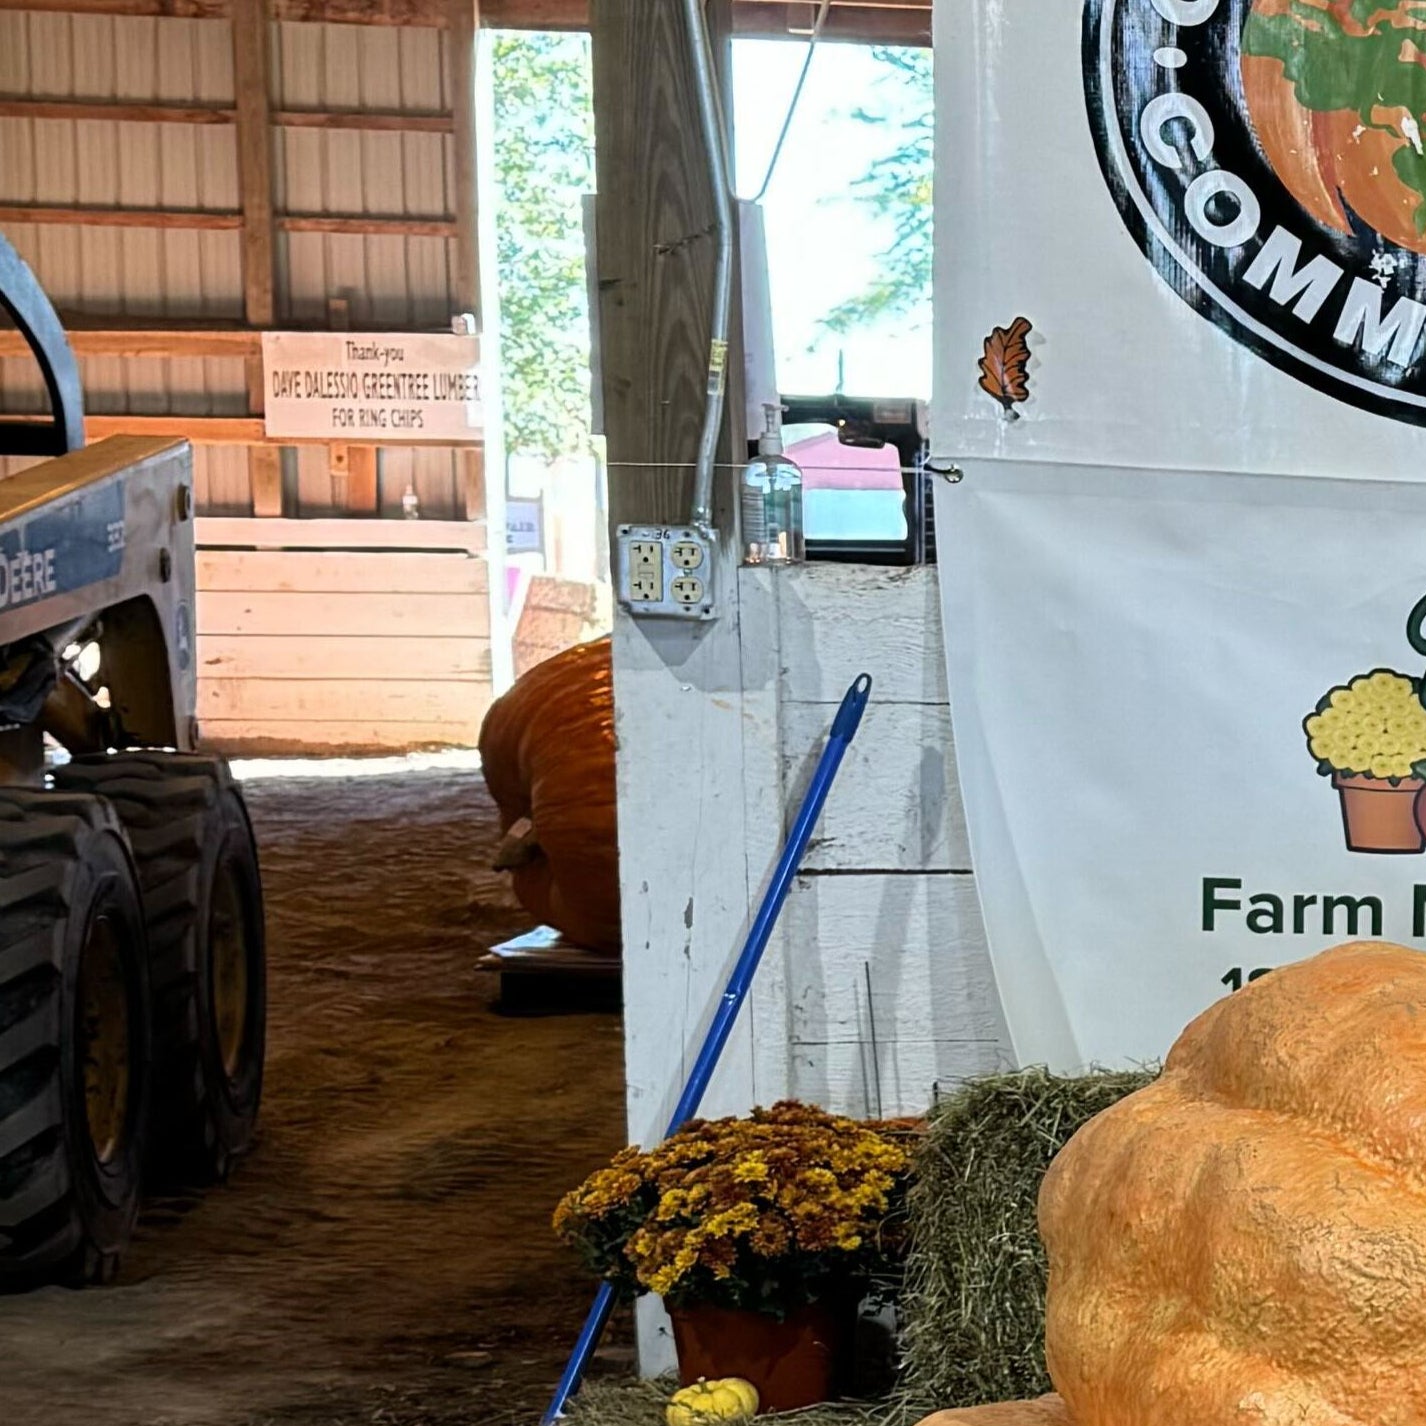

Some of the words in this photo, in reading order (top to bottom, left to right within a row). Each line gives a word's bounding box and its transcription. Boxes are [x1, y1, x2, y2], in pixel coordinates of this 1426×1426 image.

[346, 340, 404, 367] Thank-you
[272, 371, 301, 398] DAVE
[305, 371, 358, 400] DALESSIO
[362, 372, 430, 400] GREENTREE
[432, 373, 481, 401] LUMBER
[332, 408, 354, 428] FOR
[359, 408, 387, 428] RING
[391, 409, 424, 429] CHIPS
[1202, 876, 1383, 937] Farm
